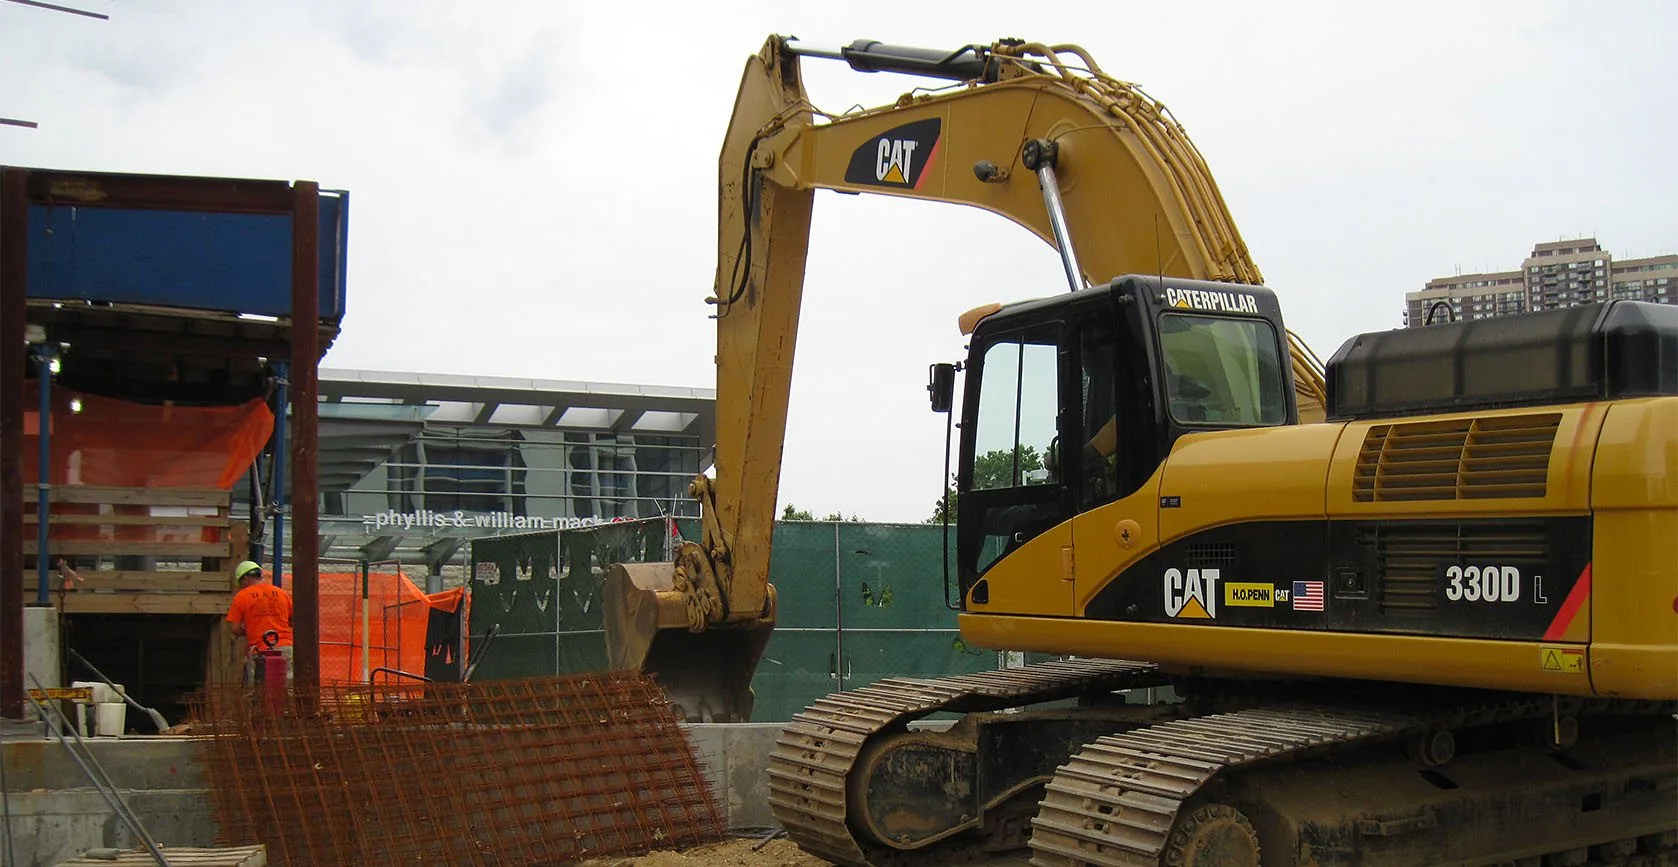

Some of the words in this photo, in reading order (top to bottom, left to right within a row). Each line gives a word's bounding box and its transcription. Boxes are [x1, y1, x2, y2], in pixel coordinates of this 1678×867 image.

[876, 138, 915, 184] CAT
[1166, 287, 1258, 313] CATERPILLAR
[376, 509, 445, 530] phyllis
[453, 511, 467, 527] &
[475, 511, 544, 528] william
[1164, 568, 1220, 618] CAT
[1275, 589, 1290, 602] CAT
[1446, 566, 1520, 602] 330D
[1533, 575, 1548, 604] L
